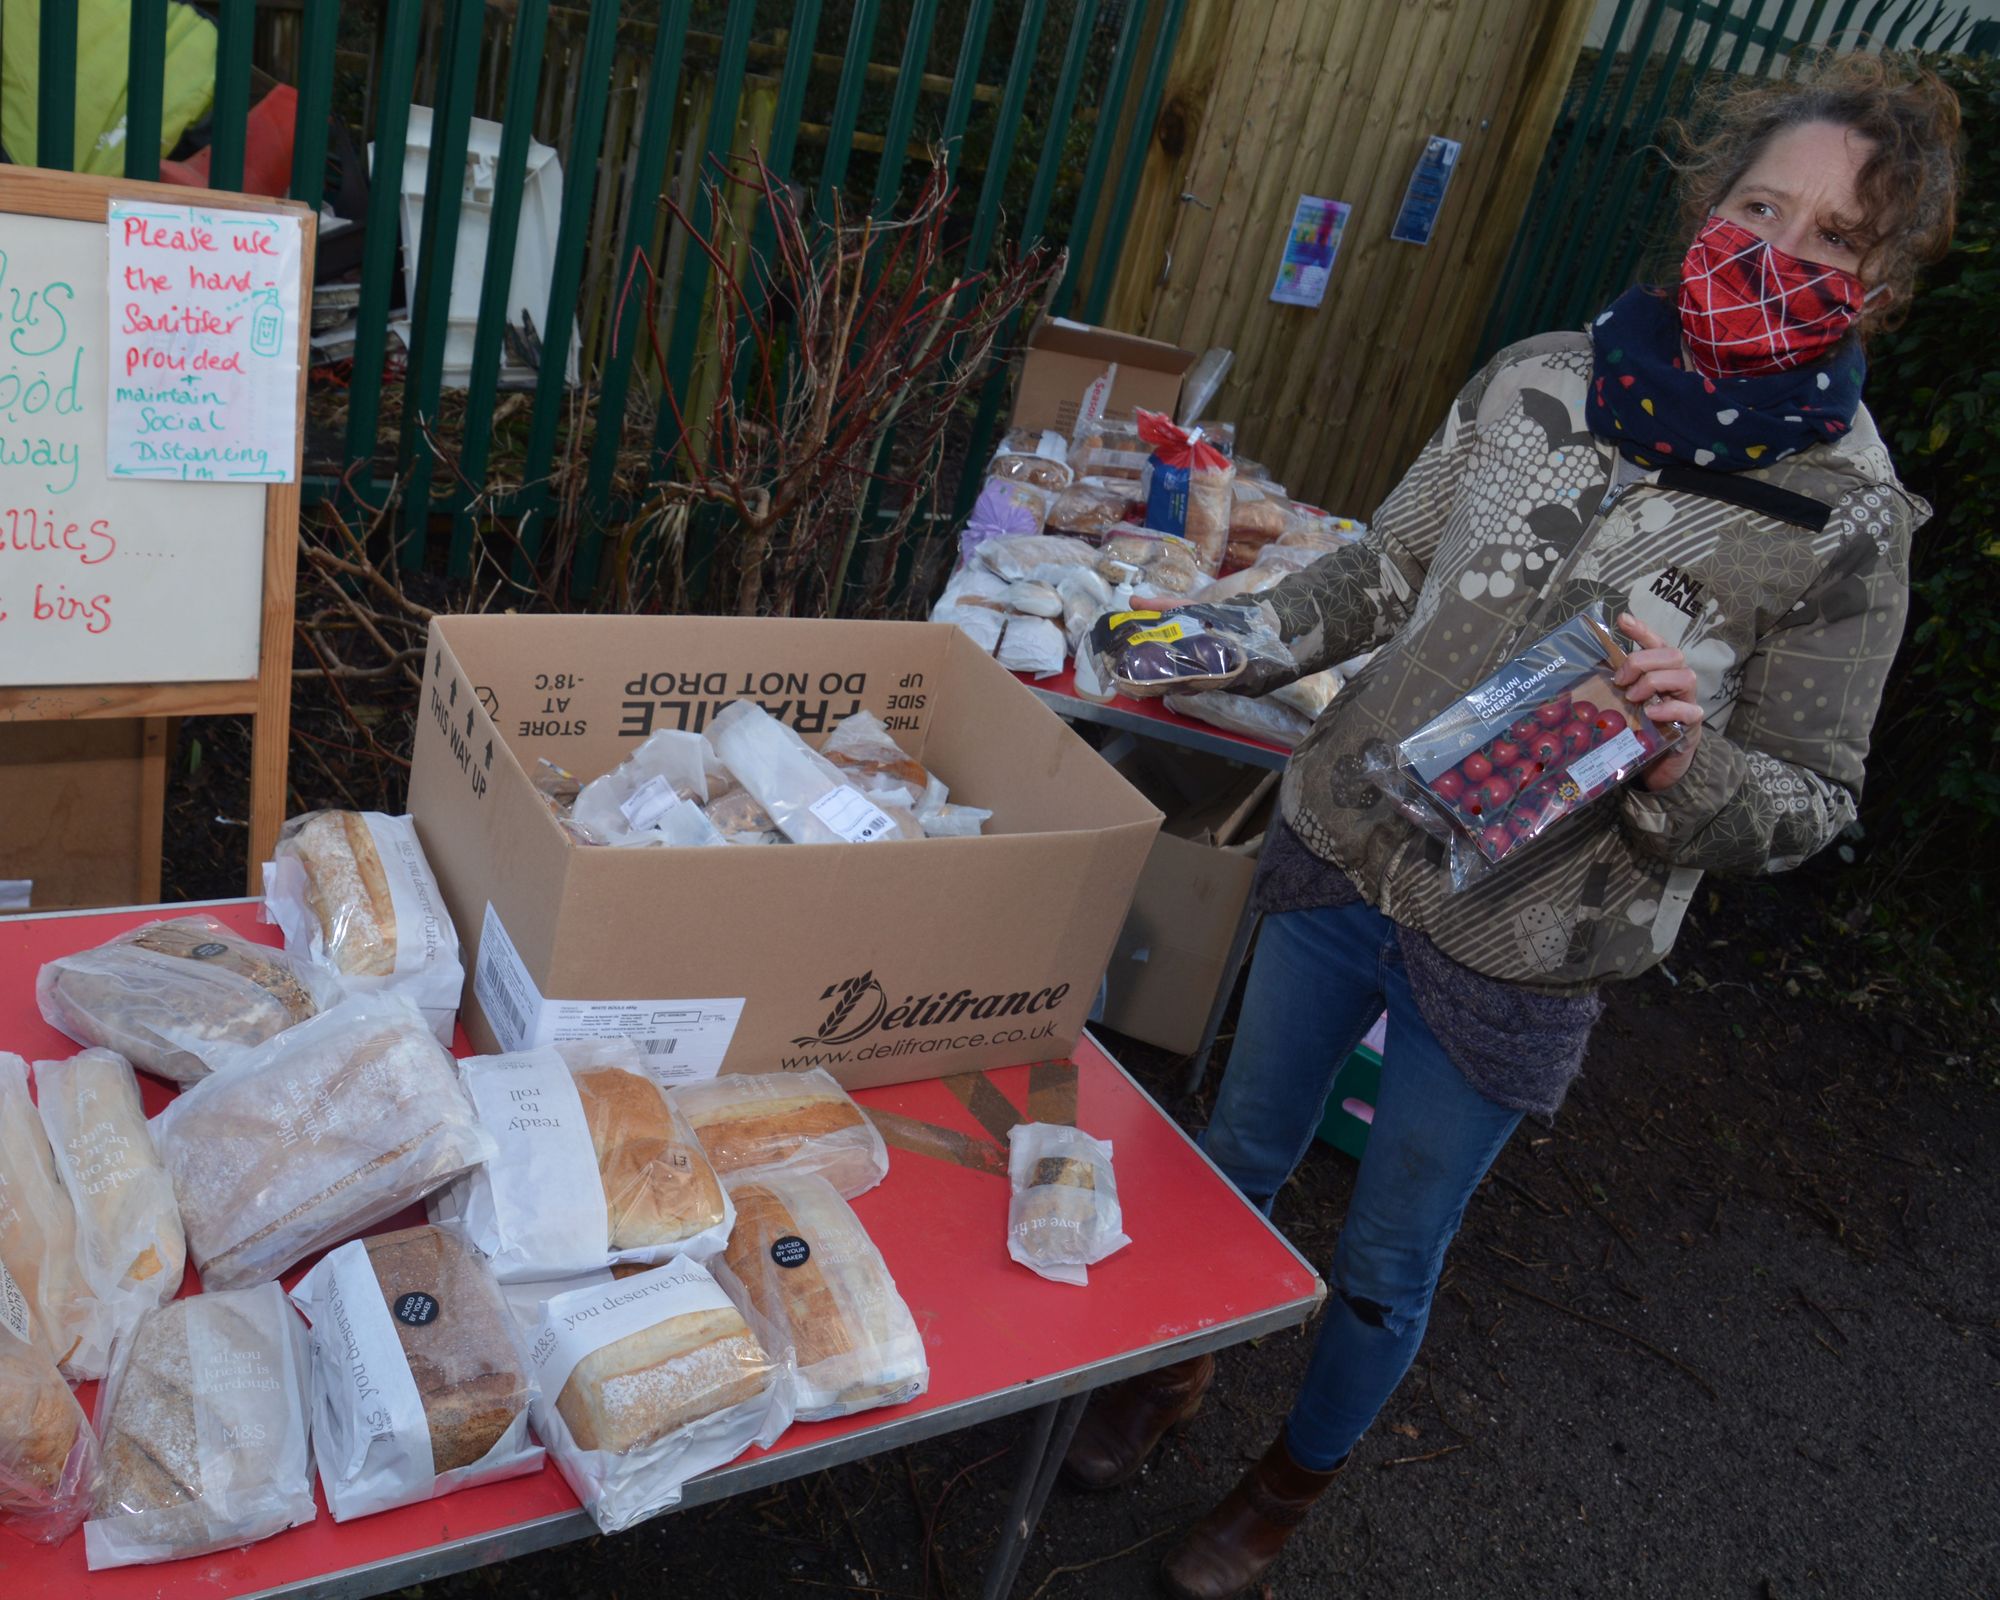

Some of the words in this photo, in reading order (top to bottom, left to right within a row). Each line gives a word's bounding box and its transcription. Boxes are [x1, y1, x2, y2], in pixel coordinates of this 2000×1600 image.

[123, 216, 218, 252] Please
[232, 230, 280, 255] use
[124, 266, 172, 294] the
[189, 265, 251, 293] hand
[0, 252, 74, 356] us
[126, 347, 245, 377] provided
[0, 346, 84, 423] ood
[116, 387, 227, 405] maintain
[137, 407, 225, 434] Social
[130, 440, 268, 475] Distancing
[0, 508, 117, 564] llies
[34, 584, 111, 634] bins
[624, 672, 728, 696] DROP
[736, 672, 809, 696] NOT
[818, 672, 867, 695] DO
[899, 673, 924, 688] UP
[1481, 691, 1517, 720] CHERRY
[1518, 655, 1567, 694] TOMATOES
[542, 697, 571, 714] AT
[886, 694, 927, 710] SIDE
[1475, 676, 1521, 712] PICCOLINI
[518, 720, 588, 737] STORE
[618, 699, 863, 738] FRAILE
[883, 716, 920, 731] THIS
[431, 685, 449, 737] THIS
[450, 721, 472, 775] WAY
[471, 763, 487, 800] UP
[789, 968, 1071, 1049] Délifrance
[780, 1020, 1059, 1071] www.delifrance.co.uk
[509, 1088, 542, 1102] roll
[520, 1102, 539, 1113] to
[277, 1119, 300, 1149] life
[508, 1115, 561, 1132] ready
[1031, 1217, 1047, 1229] at
[1049, 1217, 1080, 1234] love
[777, 1240, 801, 1250] SLICED
[786, 1246, 806, 1256] YOUR
[781, 1253, 804, 1263] BAKER
[401, 1296, 416, 1318] SLICED
[409, 1313, 417, 1323] BY
[414, 1296, 426, 1313] YOUR
[419, 1301, 433, 1321] BAKER
[333, 1300, 361, 1361] deserve
[531, 1327, 557, 1365] M&S
[563, 1306, 601, 1332] you
[602, 1277, 672, 1312] deserve
[255, 1362, 270, 1375] is
[351, 1362, 381, 1401] you
[223, 1423, 266, 1443] M&S
